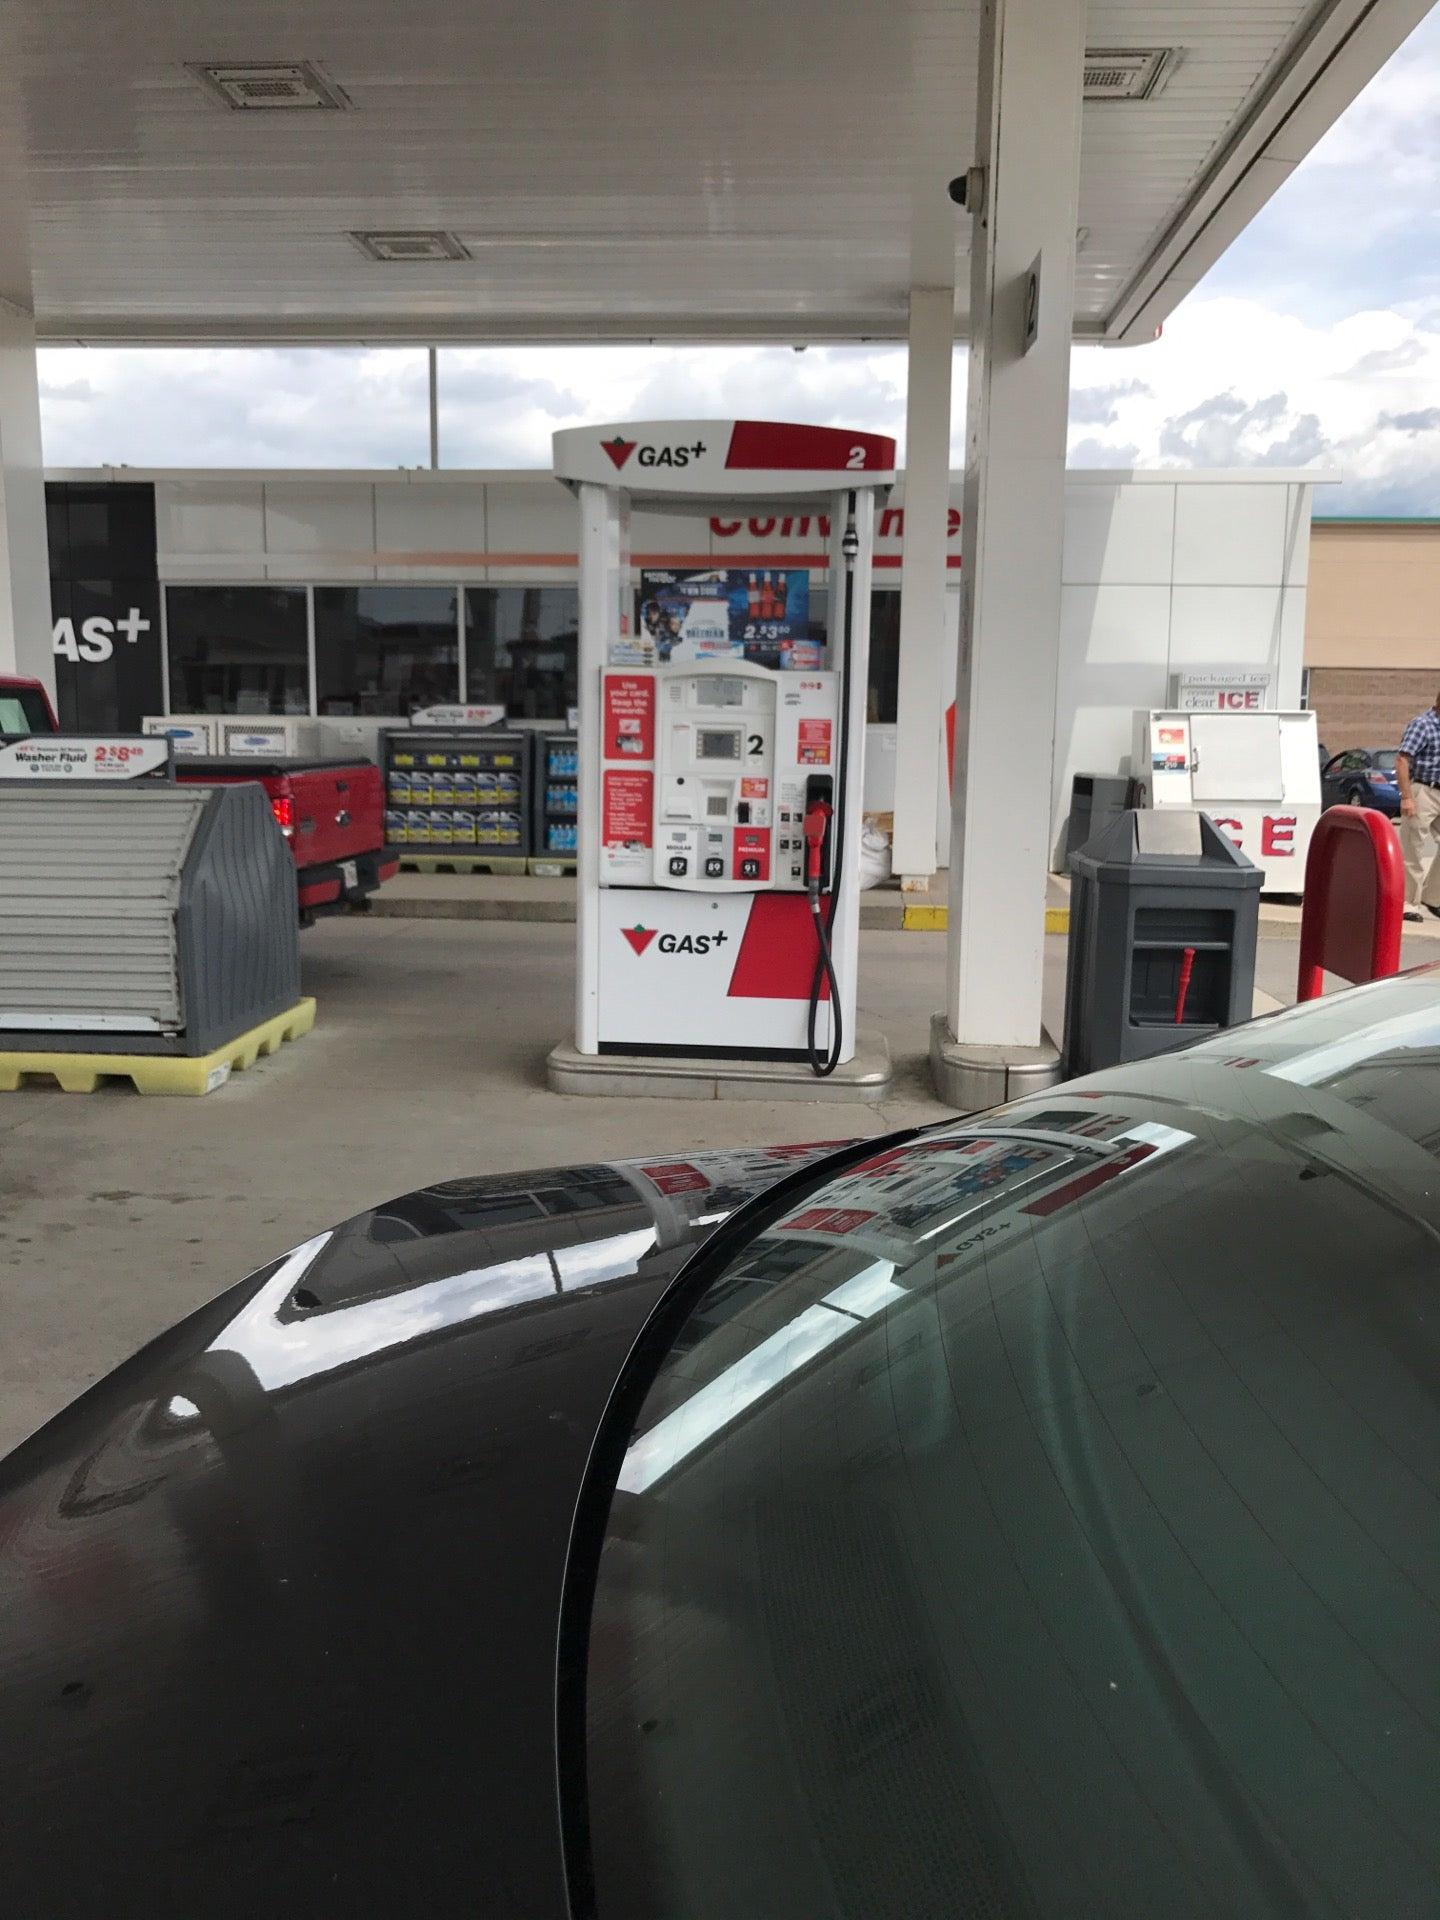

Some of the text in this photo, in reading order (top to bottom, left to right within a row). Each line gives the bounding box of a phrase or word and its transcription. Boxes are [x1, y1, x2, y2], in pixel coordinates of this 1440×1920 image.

[1027, 272, 1037, 337] 2
[638, 440, 706, 468] GAS+
[846, 446, 867, 469] 2
[1185, 691, 1260, 710] clear ICE
[747, 735, 764, 756] 2
[16, 752, 88, 763] Washer Fluid
[671, 861, 684, 870] 87
[708, 862, 721, 871] 89
[744, 864, 756, 872] 91
[658, 931, 728, 955] GAS+
